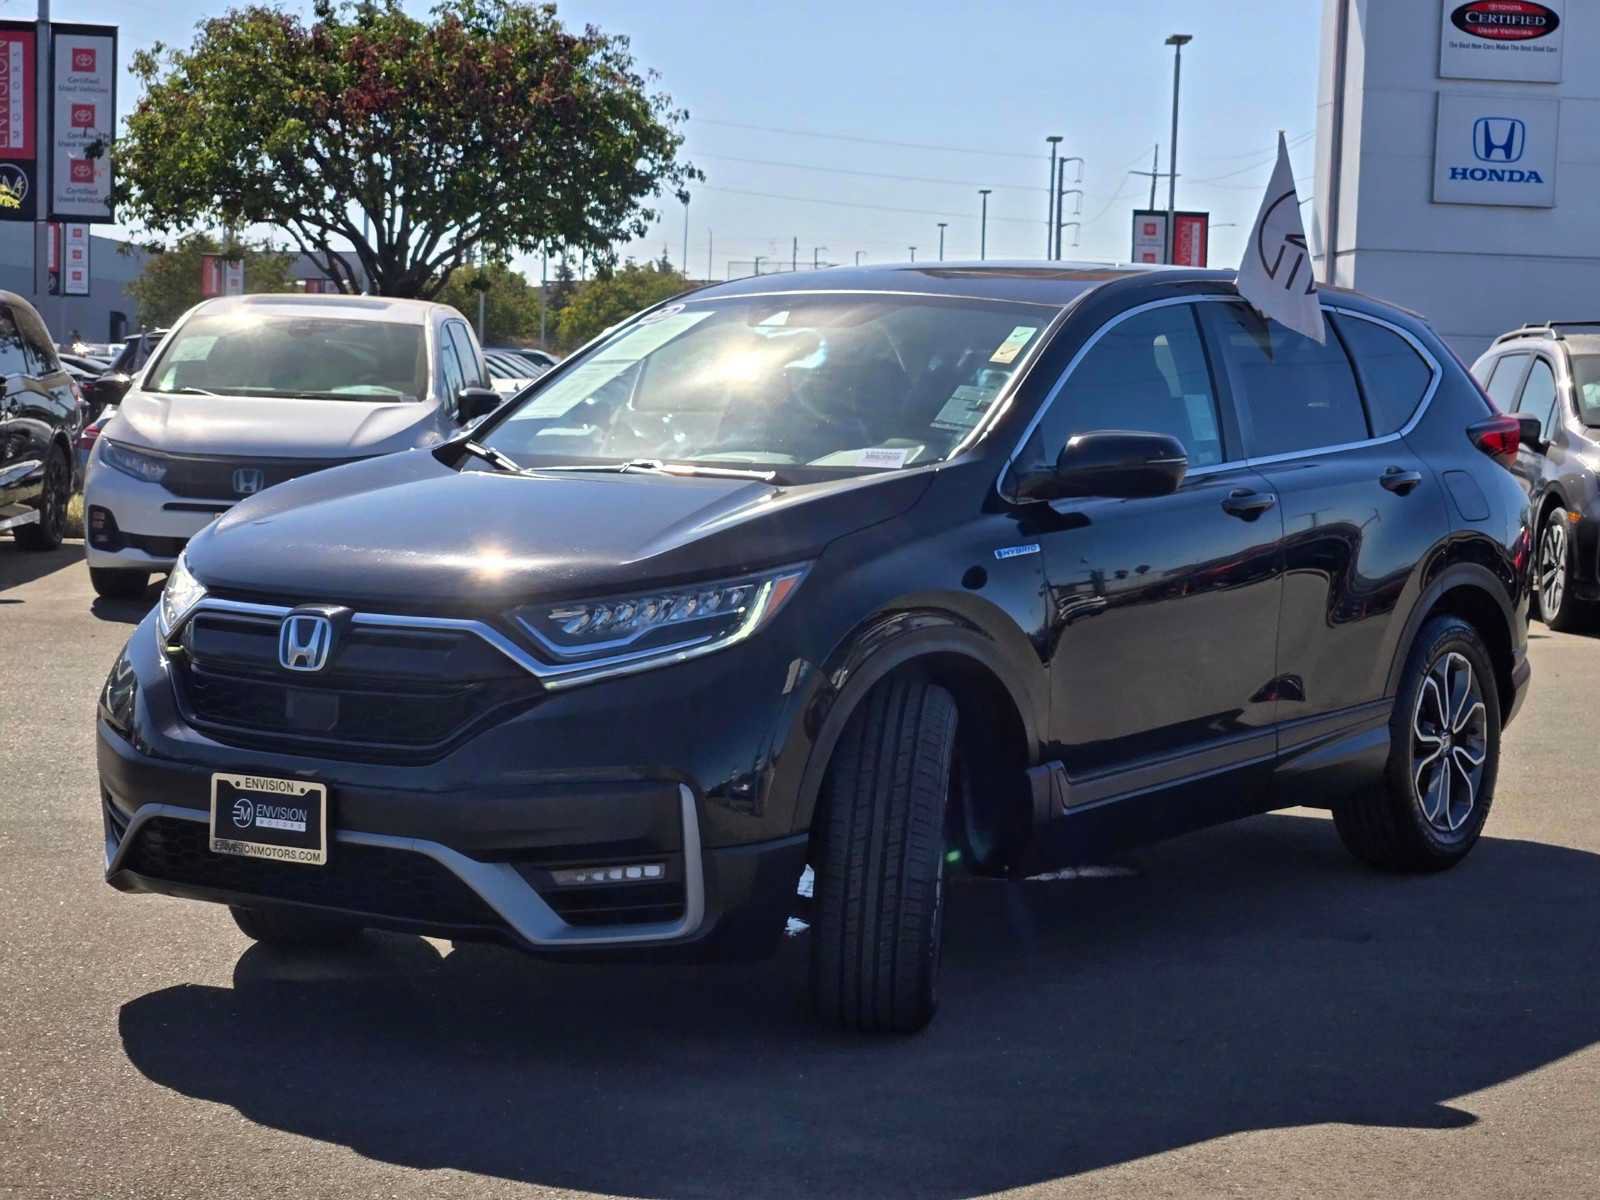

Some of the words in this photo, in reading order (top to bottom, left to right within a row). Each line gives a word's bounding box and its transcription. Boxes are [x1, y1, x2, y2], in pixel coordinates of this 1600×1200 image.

[1465, 11, 1546, 26] CERTIFIED
[1449, 167, 1544, 184] HONDA
[245, 777, 294, 793] ENVISION
[256, 804, 307, 821] ENVISION
